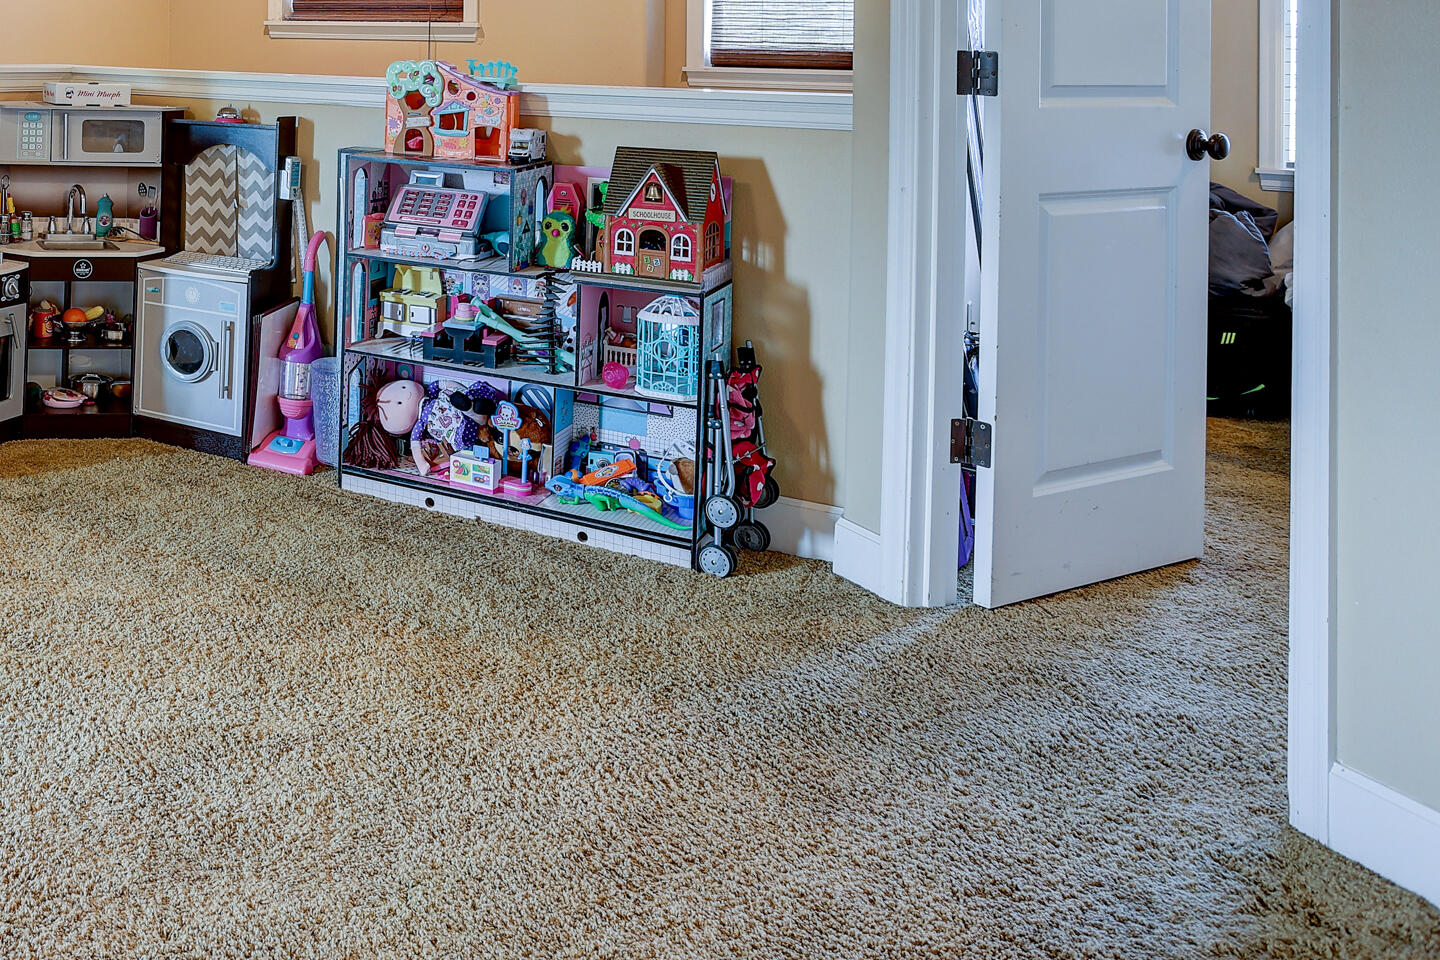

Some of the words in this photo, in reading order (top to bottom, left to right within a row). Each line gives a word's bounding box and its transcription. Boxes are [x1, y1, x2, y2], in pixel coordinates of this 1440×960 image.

[77, 90, 95, 98] Mini
[96, 90, 121, 100] Murph
[632, 210, 672, 220] SCHOOLHOUSE
